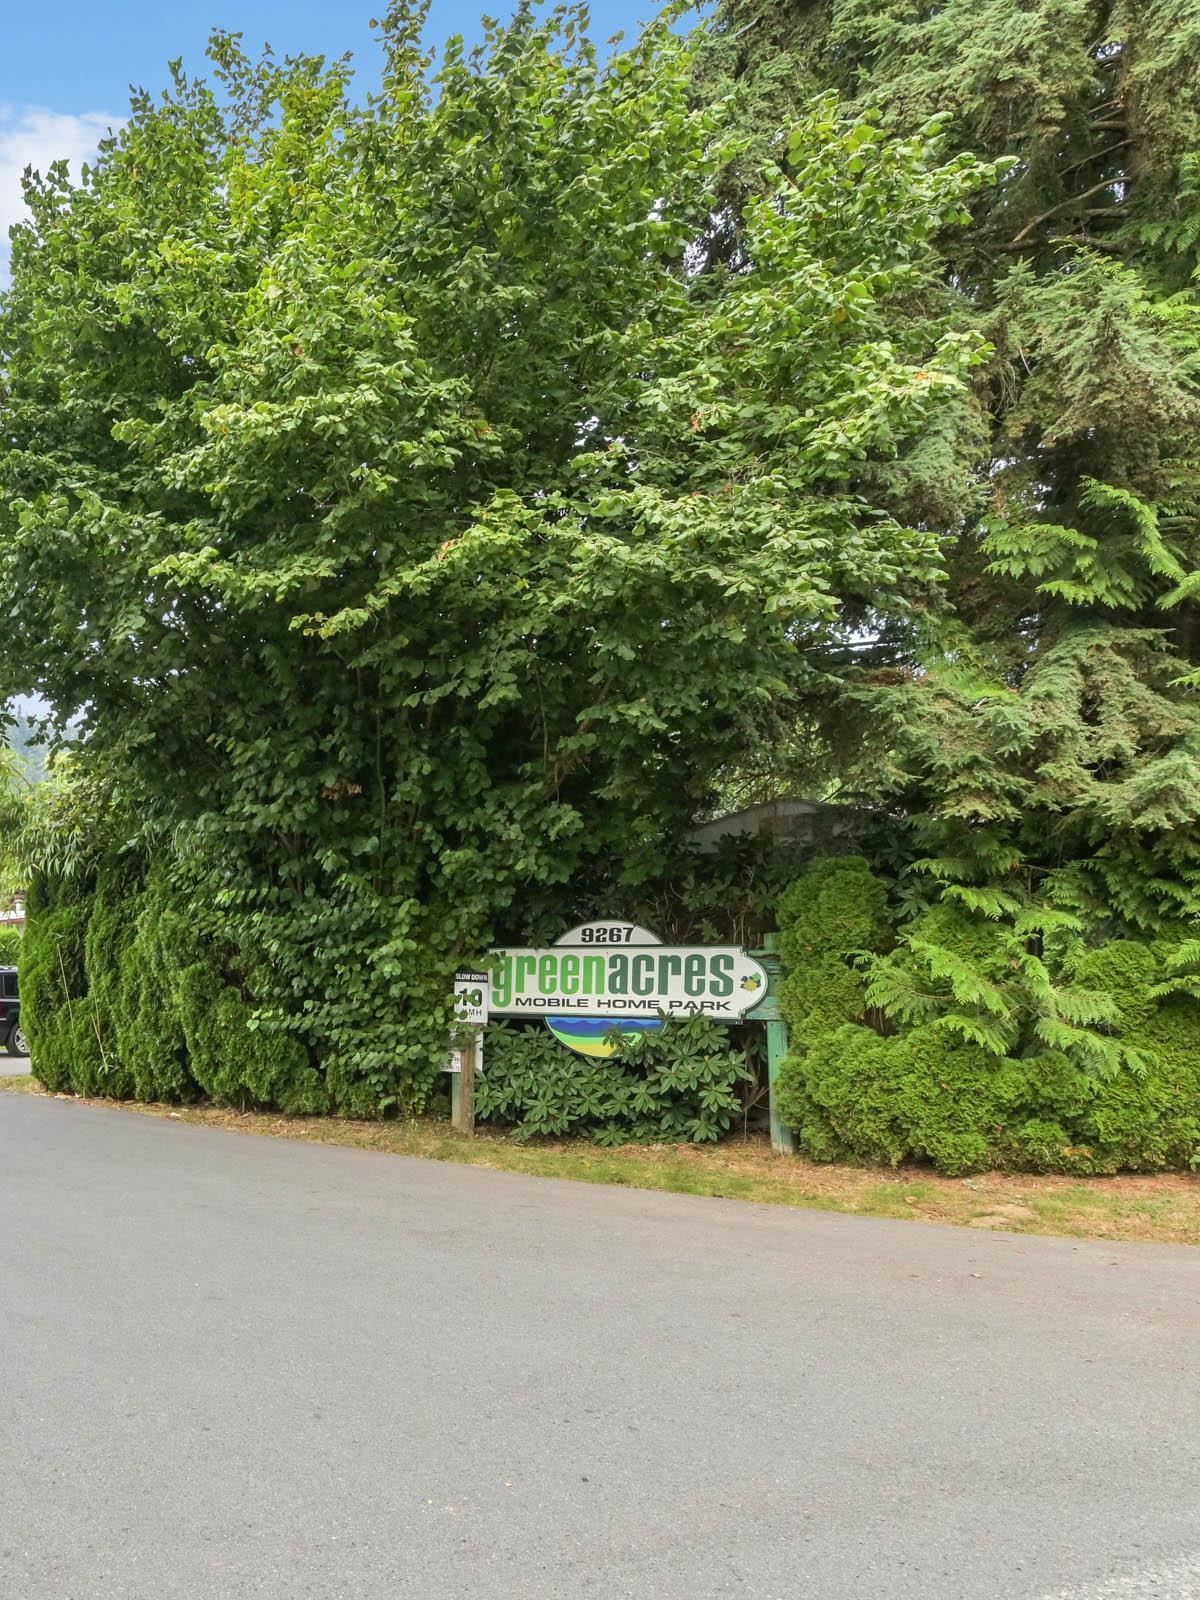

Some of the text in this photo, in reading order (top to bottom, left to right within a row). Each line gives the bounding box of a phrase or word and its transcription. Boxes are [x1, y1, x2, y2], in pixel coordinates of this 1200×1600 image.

[581, 927, 634, 943] 9267
[471, 973, 488, 981] DOWN
[491, 953, 735, 1008] greenacres
[515, 998, 731, 1011] MOBILE HOME PARK
[463, 1008, 482, 1016] MH
